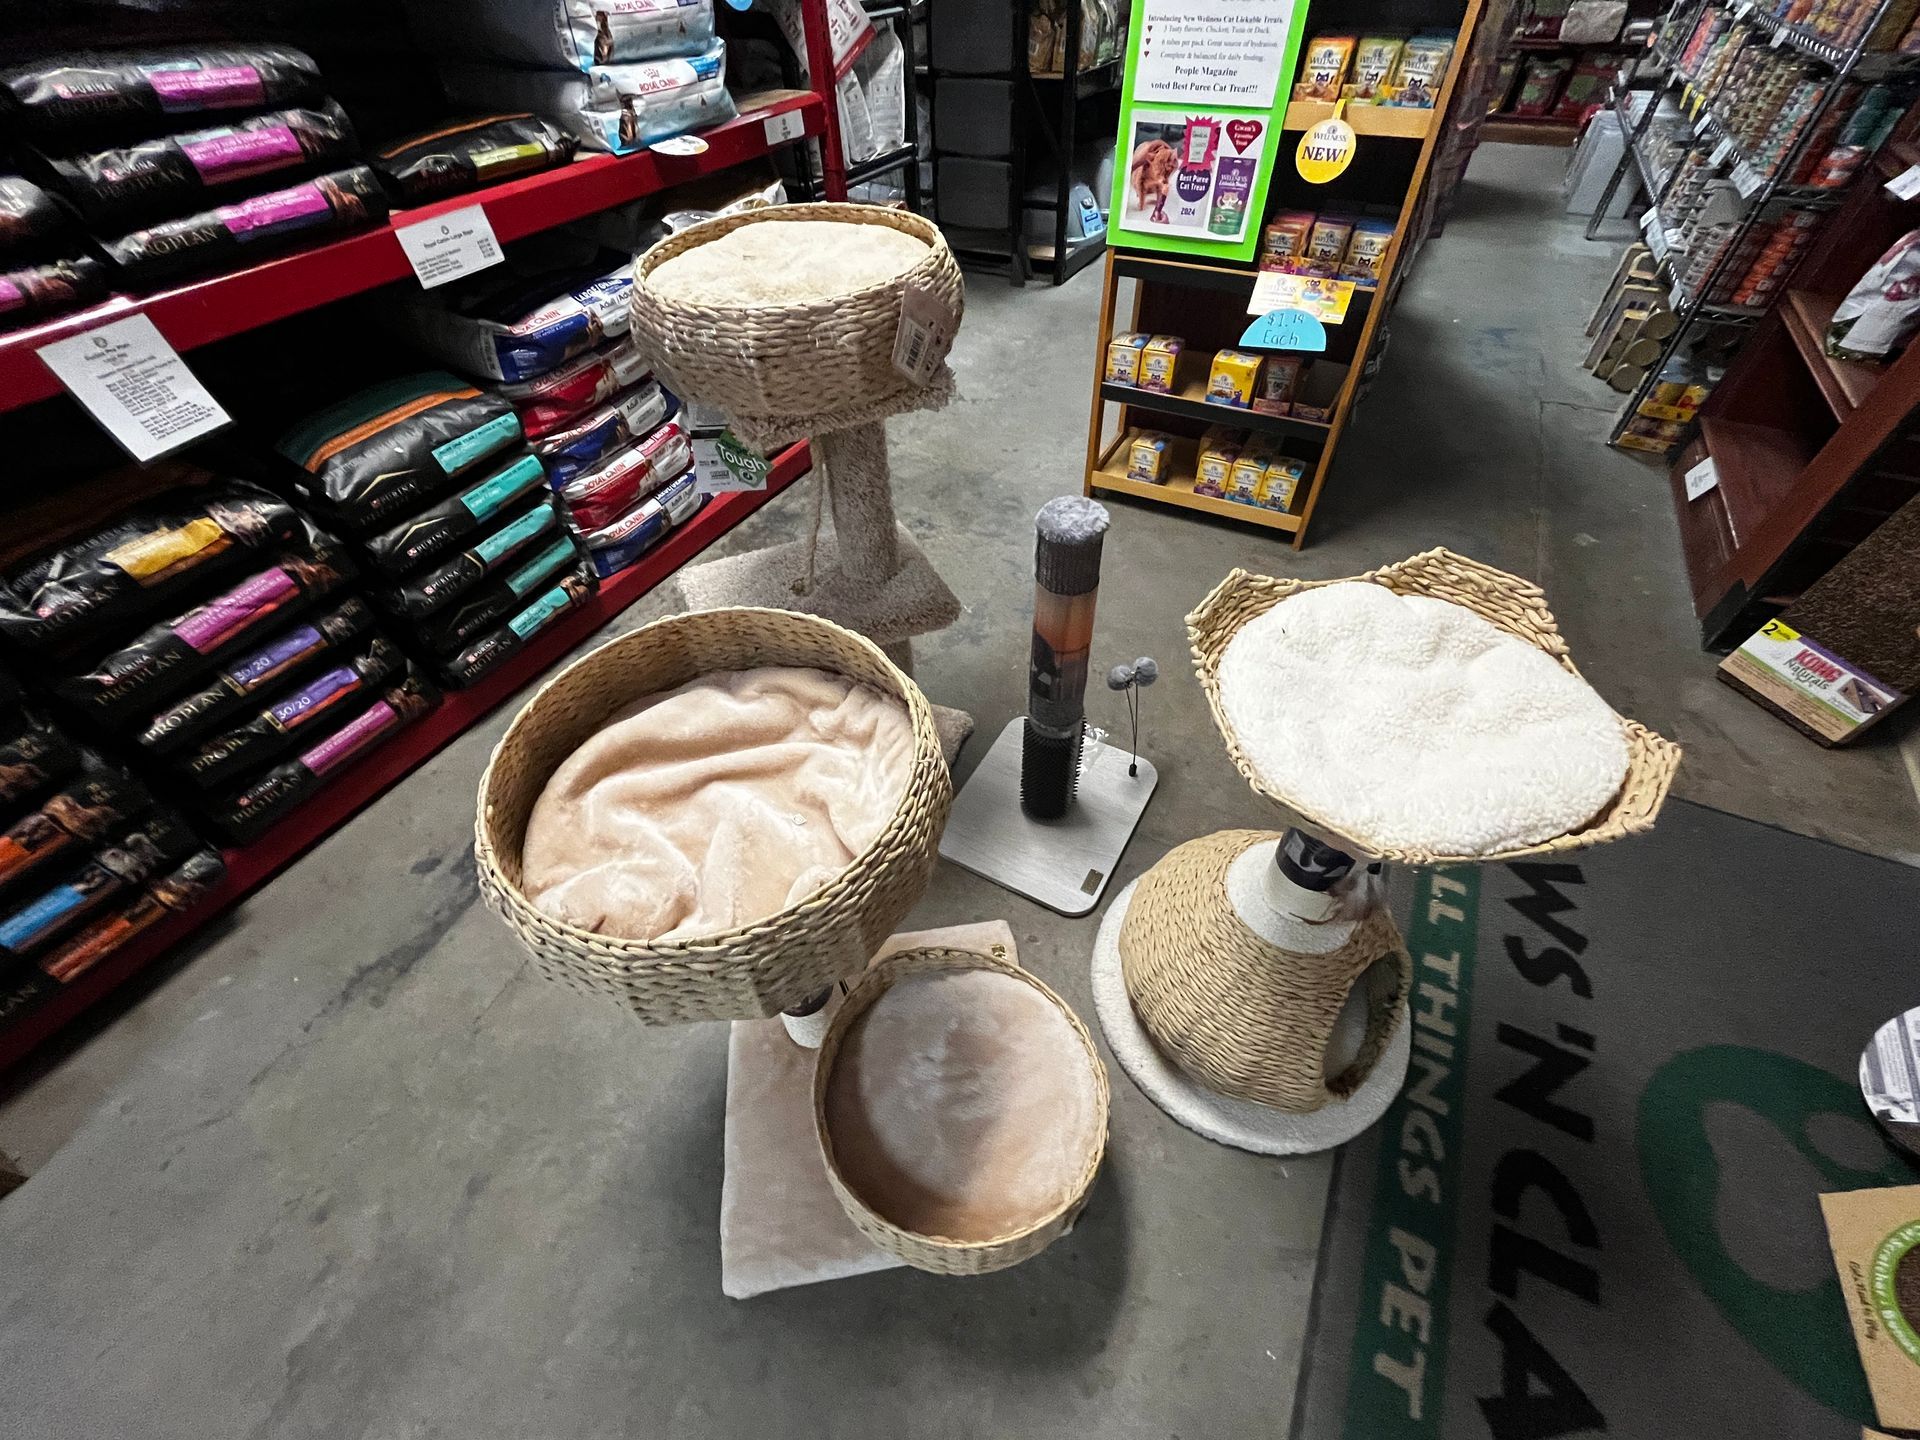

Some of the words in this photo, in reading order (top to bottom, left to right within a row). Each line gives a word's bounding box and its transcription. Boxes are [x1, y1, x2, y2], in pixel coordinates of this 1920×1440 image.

[1310, 55, 1342, 65] WELLNESS
[1174, 65, 1199, 75] People
[1201, 66, 1238, 77] Magazine
[1151, 82, 1170, 90] voted
[1172, 82, 1188, 90] Best
[1190, 82, 1211, 91] Puree
[1213, 83, 1226, 92] Cat
[1229, 84, 1258, 93] Treat!!!
[1313, 131, 1347, 142] WELLNESS
[1301, 146, 1347, 163] NEW!
[1179, 174, 1192, 182] Best
[1193, 174, 1209, 183] Puree
[1179, 182, 1190, 190] Cat
[1190, 183, 1206, 191] Treat
[1180, 207, 1196, 216] 2024
[1263, 330, 1299, 346] Each
[717, 443, 768, 472] Tough
[584, 475, 606, 491] ROYAL
[432, 568, 460, 589] PURINA
[1762, 622, 1778, 636] 2
[474, 639, 496, 659] PURINA
[113, 654, 150, 679] PURINA
[233, 656, 270, 681] 30/20
[1784, 657, 1832, 690] Naturals
[1794, 649, 1846, 683] KONG
[276, 695, 311, 720] 30/20
[1424, 862, 1468, 926] LL
[1398, 949, 1462, 1205] THINGS
[1373, 1226, 1437, 1421] PET
